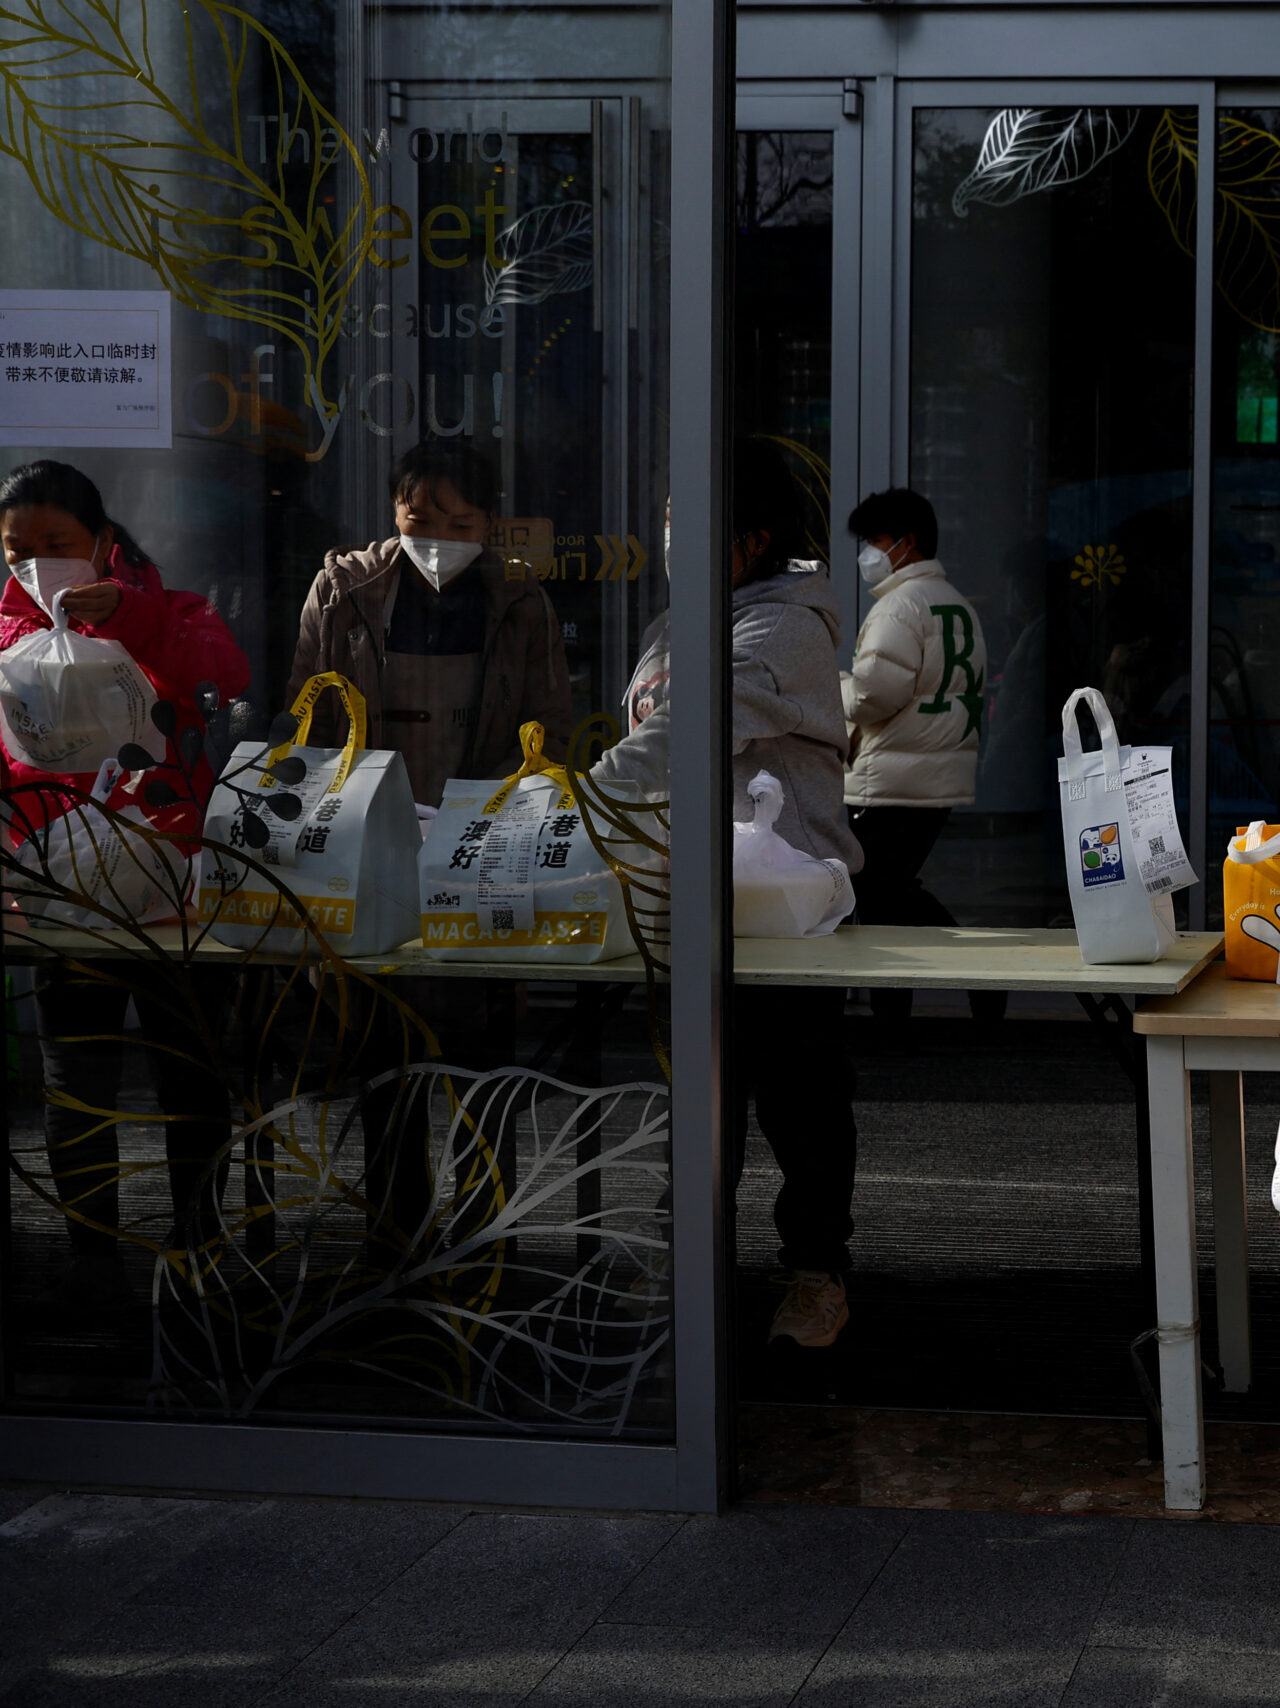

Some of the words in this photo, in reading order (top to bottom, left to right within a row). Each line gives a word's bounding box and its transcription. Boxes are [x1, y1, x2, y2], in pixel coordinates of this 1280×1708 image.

[248, 112, 342, 164] The
[241, 188, 509, 269] sweet
[5, 366, 143, 384] 带来不便敬请谅解。
[186, 344, 276, 436] of
[303, 371, 506, 462] you!
[202, 896, 274, 919] MACAU
